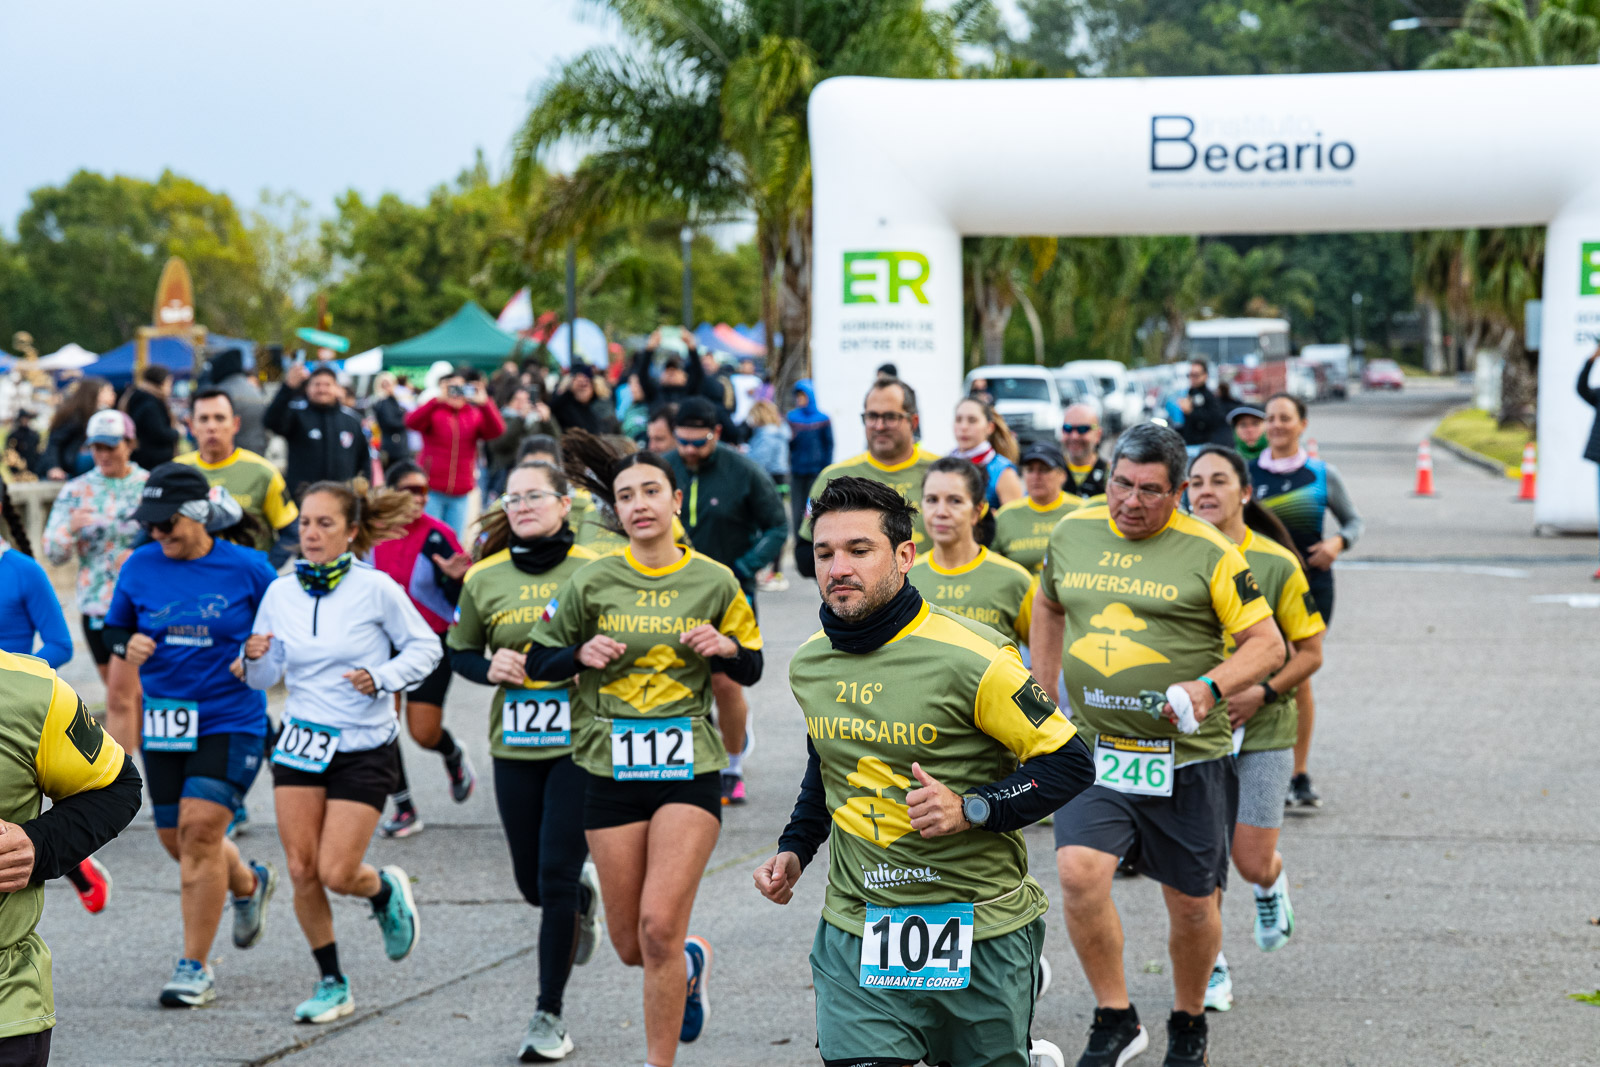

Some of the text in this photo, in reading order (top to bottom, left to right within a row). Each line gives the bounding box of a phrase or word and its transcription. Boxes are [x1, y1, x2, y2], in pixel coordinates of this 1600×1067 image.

[1149, 115, 1356, 172] Becario
[842, 251, 930, 304] ER
[1098, 551, 1142, 569] 216°
[635, 589, 679, 608] 216°
[1061, 571, 1179, 602] ANIVERSARIO
[836, 680, 883, 705] 216°
[149, 706, 190, 738] 119
[508, 698, 563, 733] 122
[284, 724, 331, 762] 023
[619, 727, 685, 767] 112
[617, 769, 660, 780] DIAMANTE
[1100, 753, 1166, 788] 246
[872, 915, 963, 972] 104
[864, 975, 965, 988] DIAMANTE CORRE
